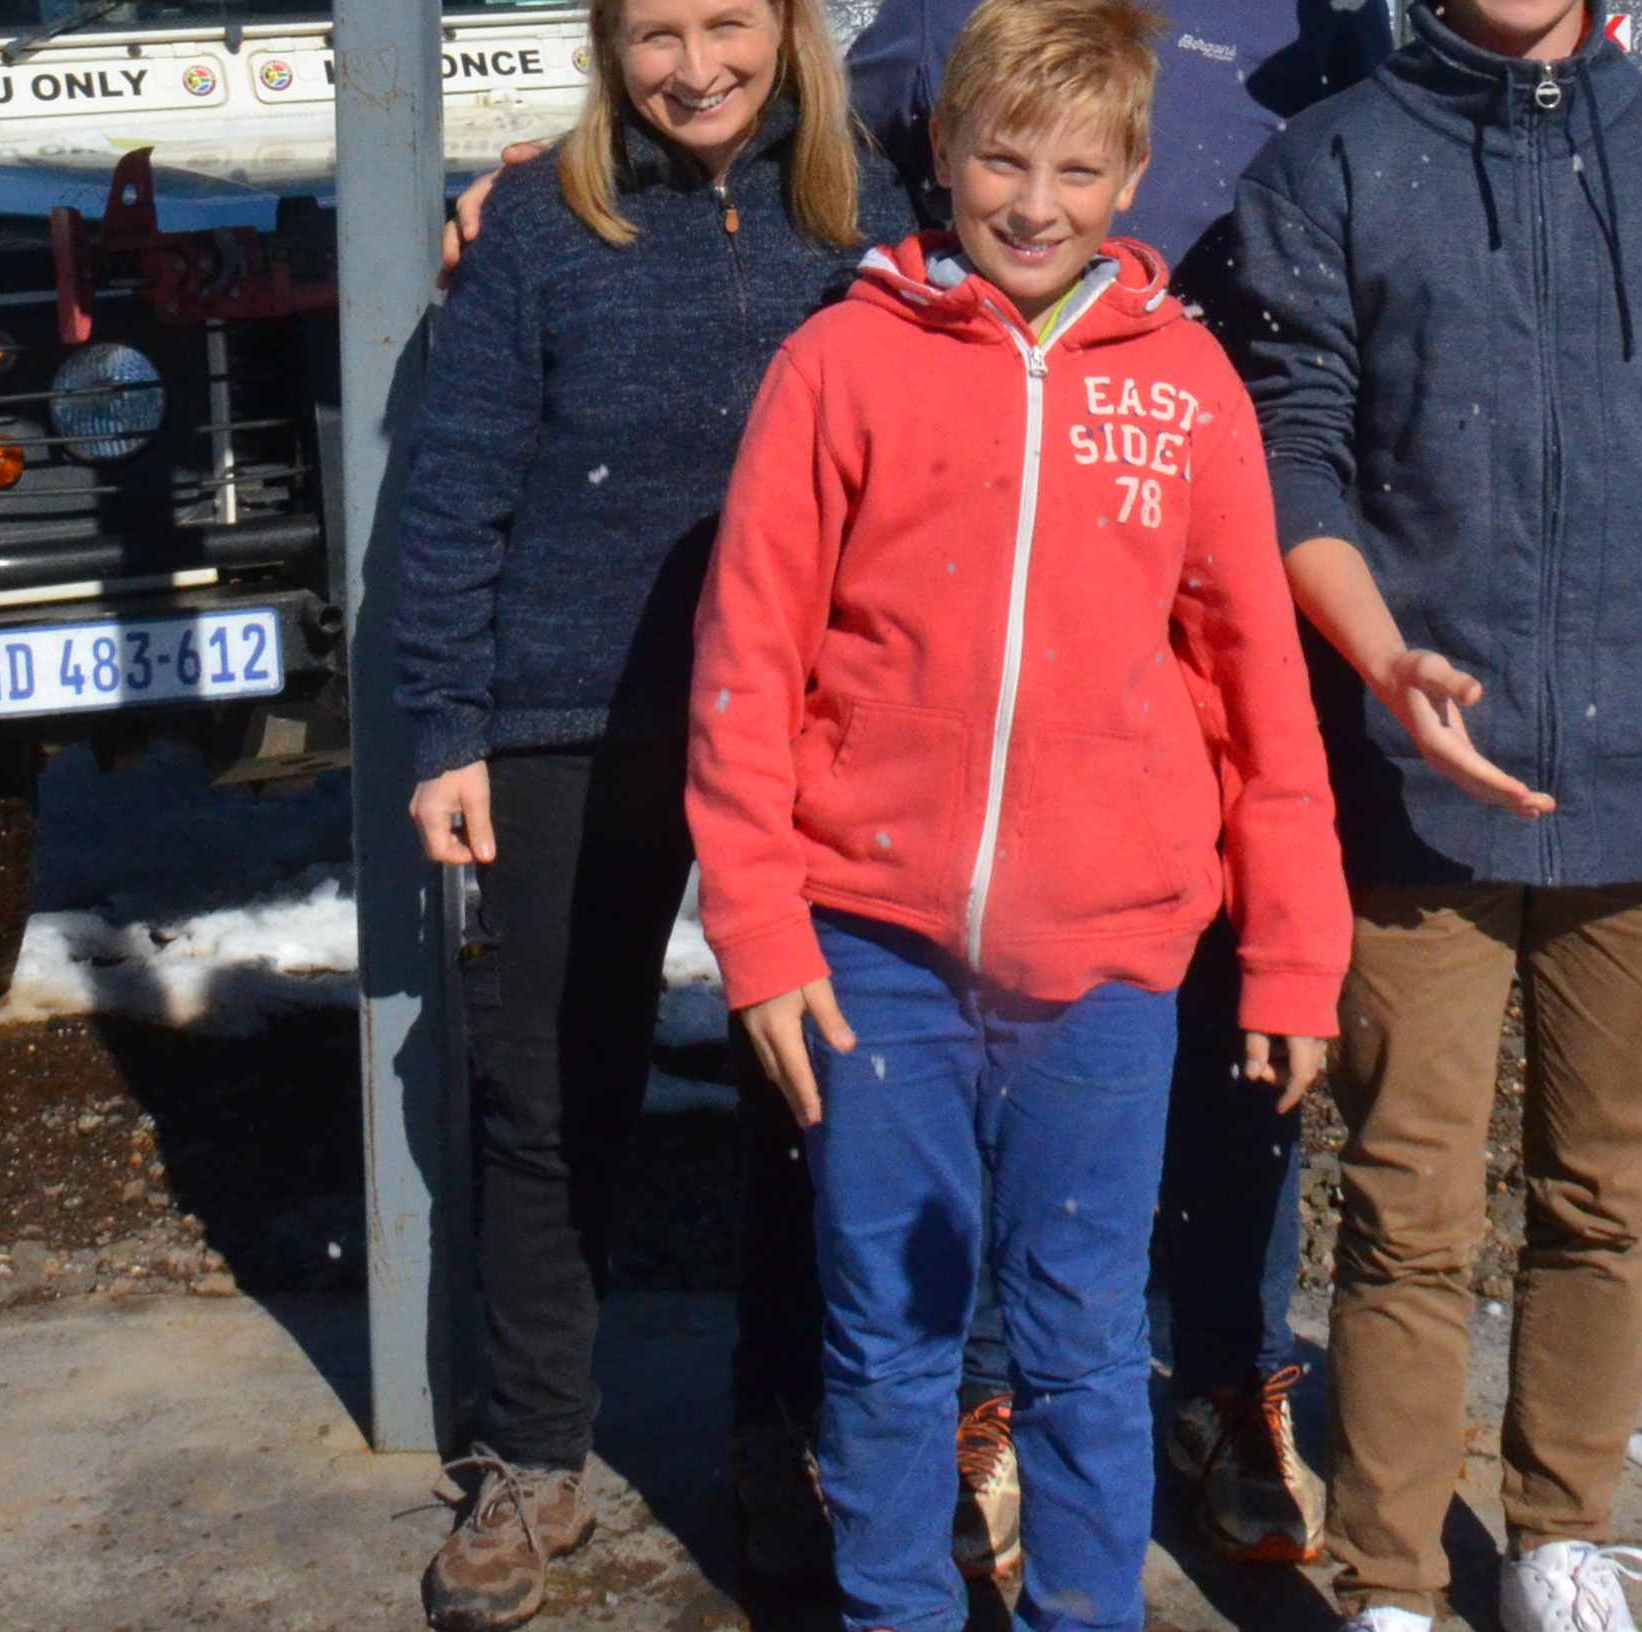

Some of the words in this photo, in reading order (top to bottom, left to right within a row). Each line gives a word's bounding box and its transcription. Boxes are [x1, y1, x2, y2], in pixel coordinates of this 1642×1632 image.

[31, 68, 148, 101] ONLY
[1084, 375, 1200, 432] EAST
[1069, 422, 1191, 482] SIDE
[1116, 476, 1162, 529] 78
[59, 622, 270, 696] 483-612
